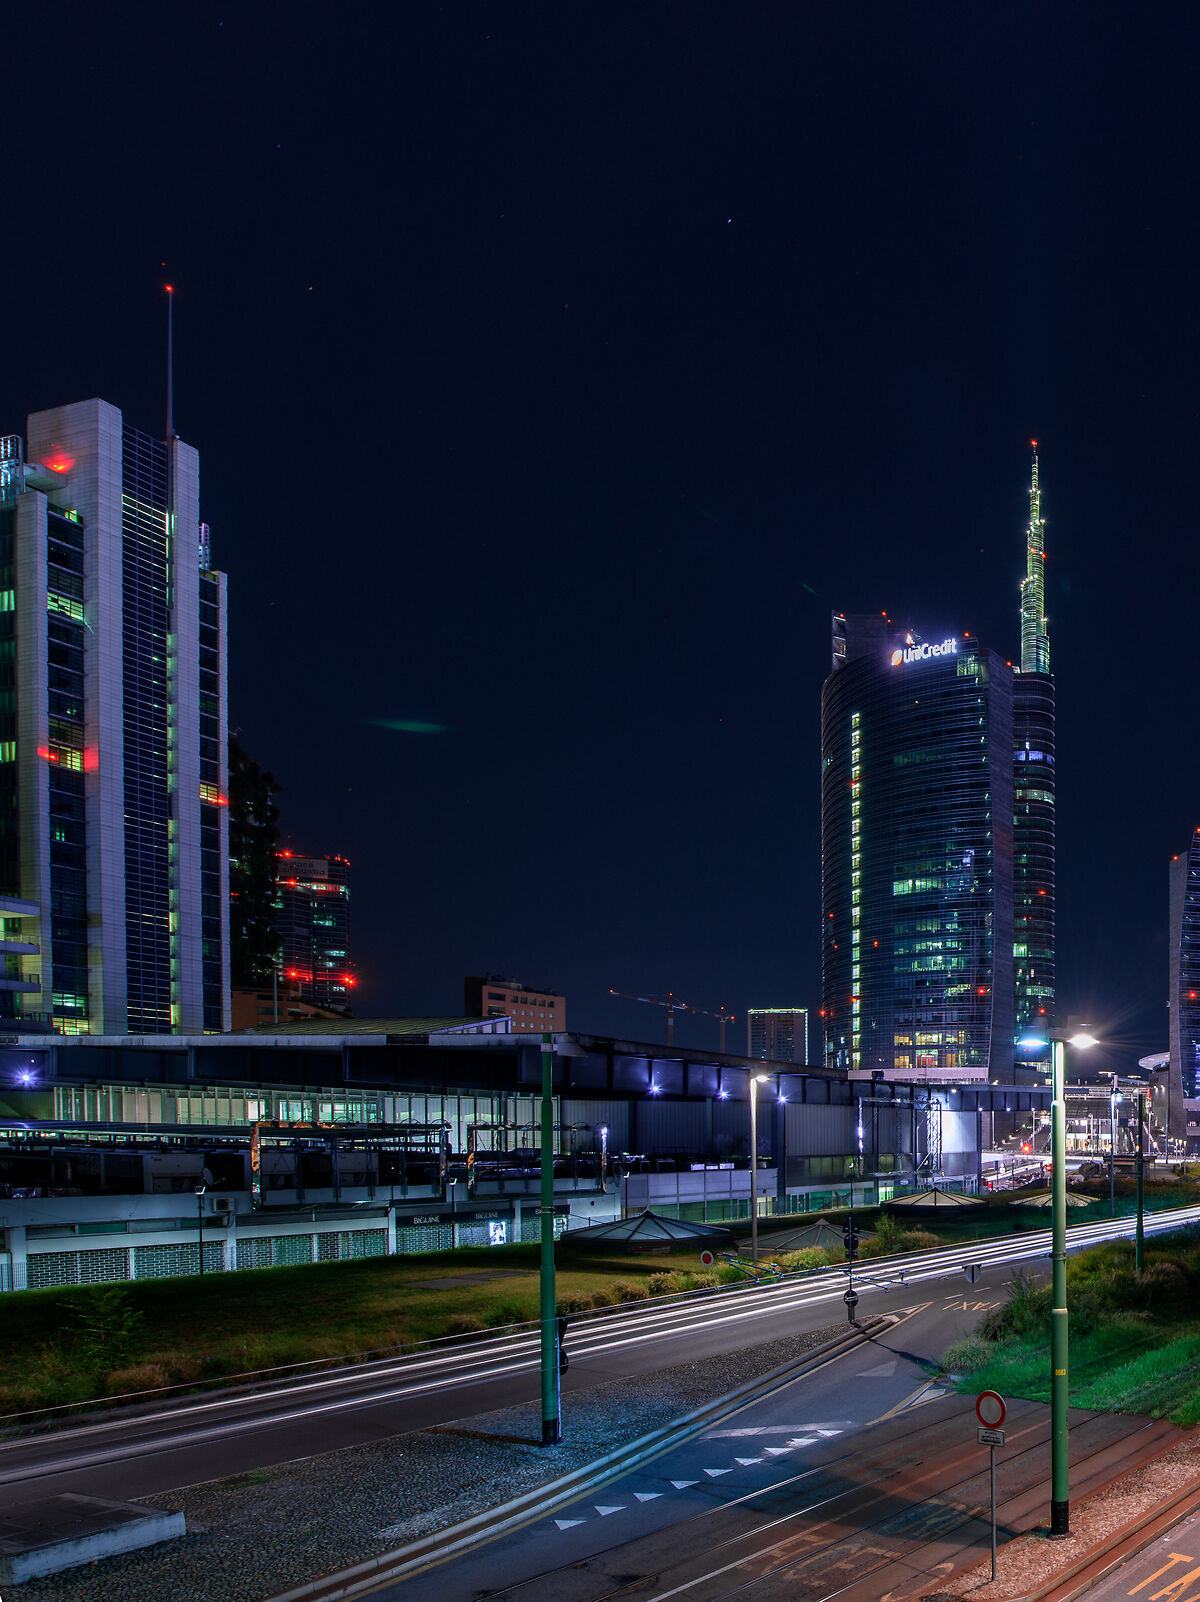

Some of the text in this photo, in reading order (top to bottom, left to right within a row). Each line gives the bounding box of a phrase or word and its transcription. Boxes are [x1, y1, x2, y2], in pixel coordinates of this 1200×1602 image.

[903, 638, 956, 663] UniCredit
[475, 1211, 499, 1219] BIGUINE
[413, 1216, 441, 1225] BIGUINE
